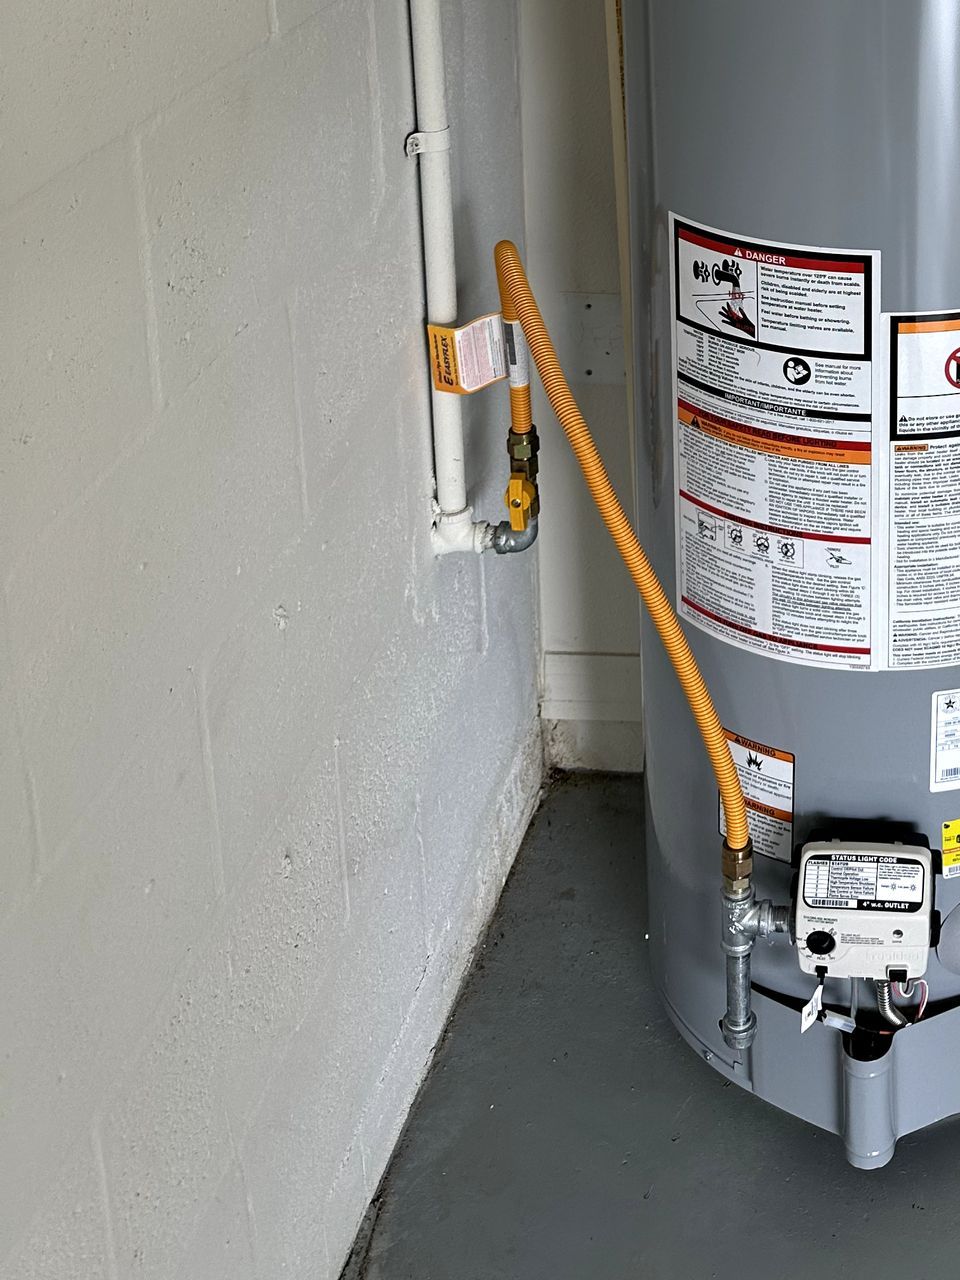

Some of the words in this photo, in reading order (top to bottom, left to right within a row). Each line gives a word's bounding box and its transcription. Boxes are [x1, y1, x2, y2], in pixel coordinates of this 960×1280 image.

[746, 250, 786, 265] DANGER
[724, 393, 807, 416] IMPORTANT/IMPORTANTE
[742, 739, 776, 757] WARNING
